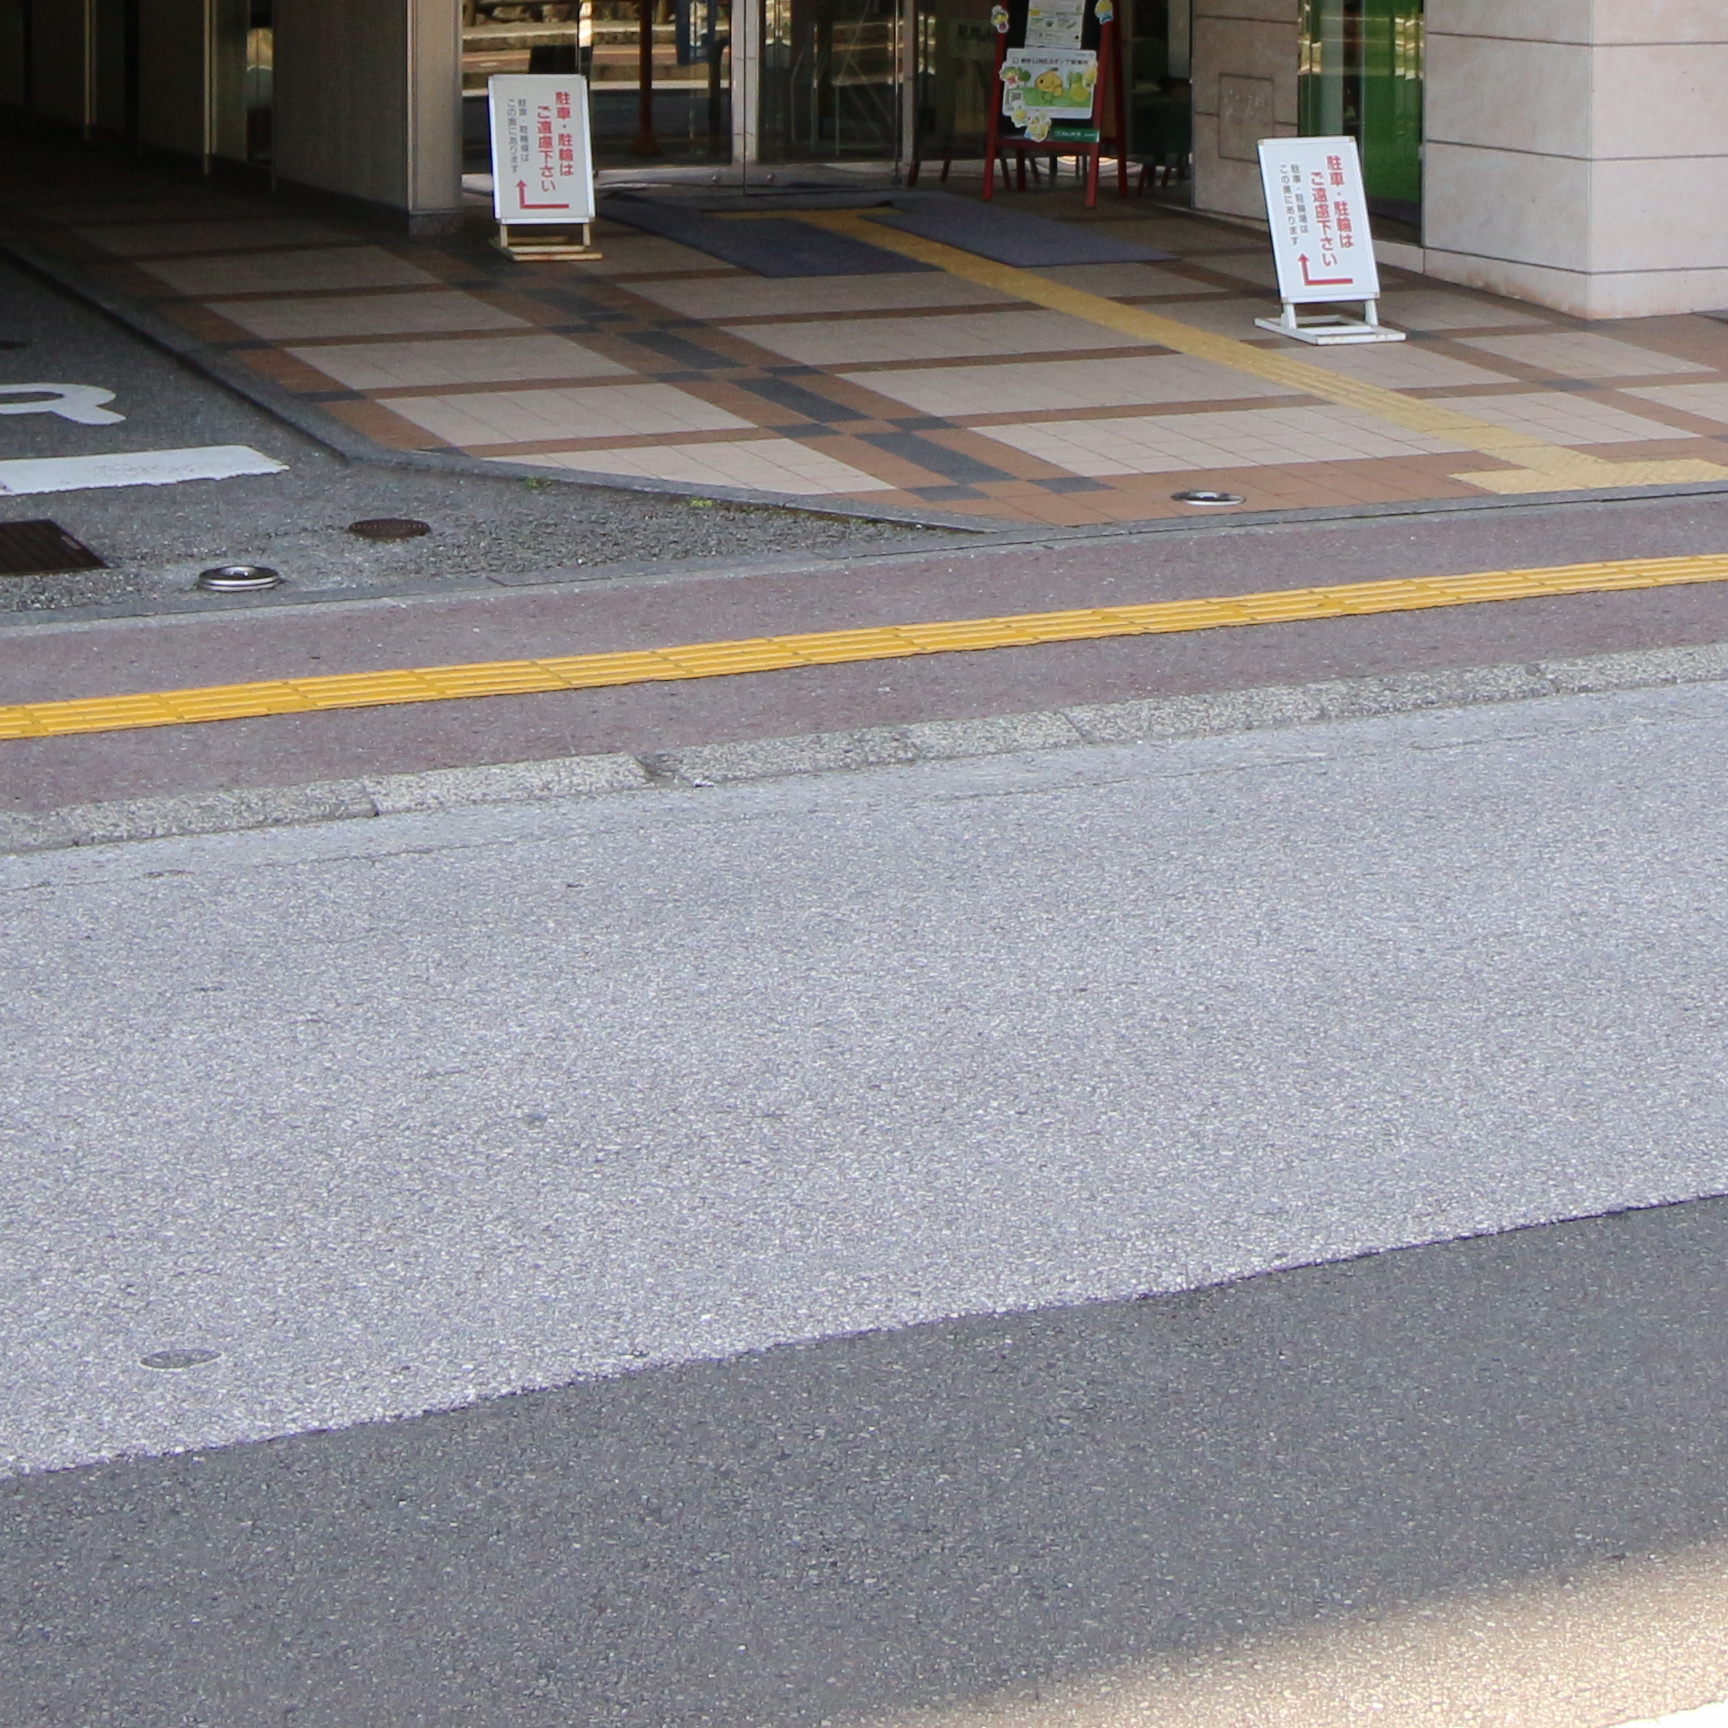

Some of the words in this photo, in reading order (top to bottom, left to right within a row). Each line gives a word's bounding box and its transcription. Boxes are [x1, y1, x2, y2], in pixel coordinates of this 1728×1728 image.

[536, 105, 556, 192] ご遠慮下さい
[555, 91, 574, 176] 駐車・駐輪は
[1310, 172, 1338, 267] ご遠慮下さい
[1326, 155, 1354, 248] 駐車・駐輪は
